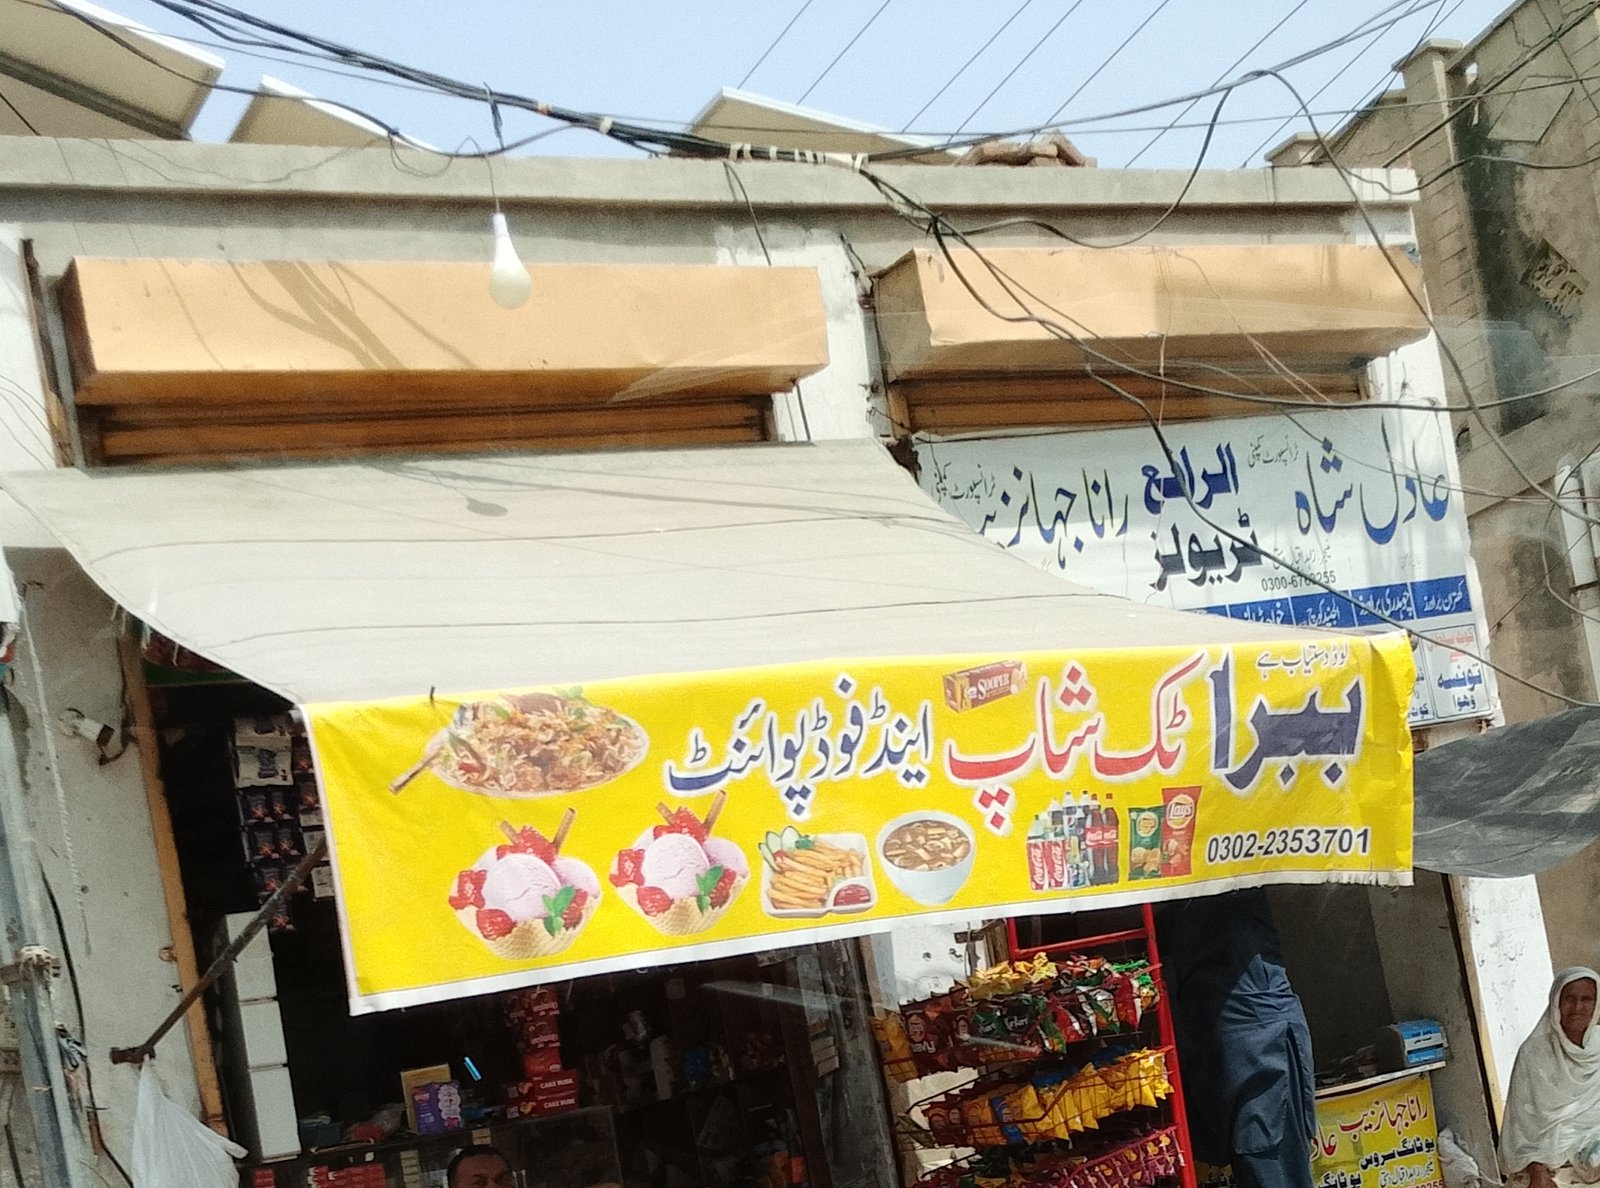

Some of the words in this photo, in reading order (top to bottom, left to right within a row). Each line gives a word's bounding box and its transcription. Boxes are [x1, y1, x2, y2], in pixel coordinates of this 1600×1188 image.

[1080, 467, 1129, 540] رانا
[1295, 436, 1353, 535] شاہ
[1360, 415, 1450, 545] عادل
[1149, 507, 1263, 592] ٹریولز
[1096, 650, 1206, 777] ٹک
[1257, 653, 1280, 680] ہے
[669, 702, 807, 816] پوائنٹ
[810, 677, 866, 778] فوڈ
[864, 690, 930, 784] اینڈ
[948, 664, 1100, 831] شاپ
[1207, 828, 1370, 865] 0302-2353701
[1339, 1099, 1408, 1140] جہانزیب
[1406, 1093, 1428, 1121] رانا
